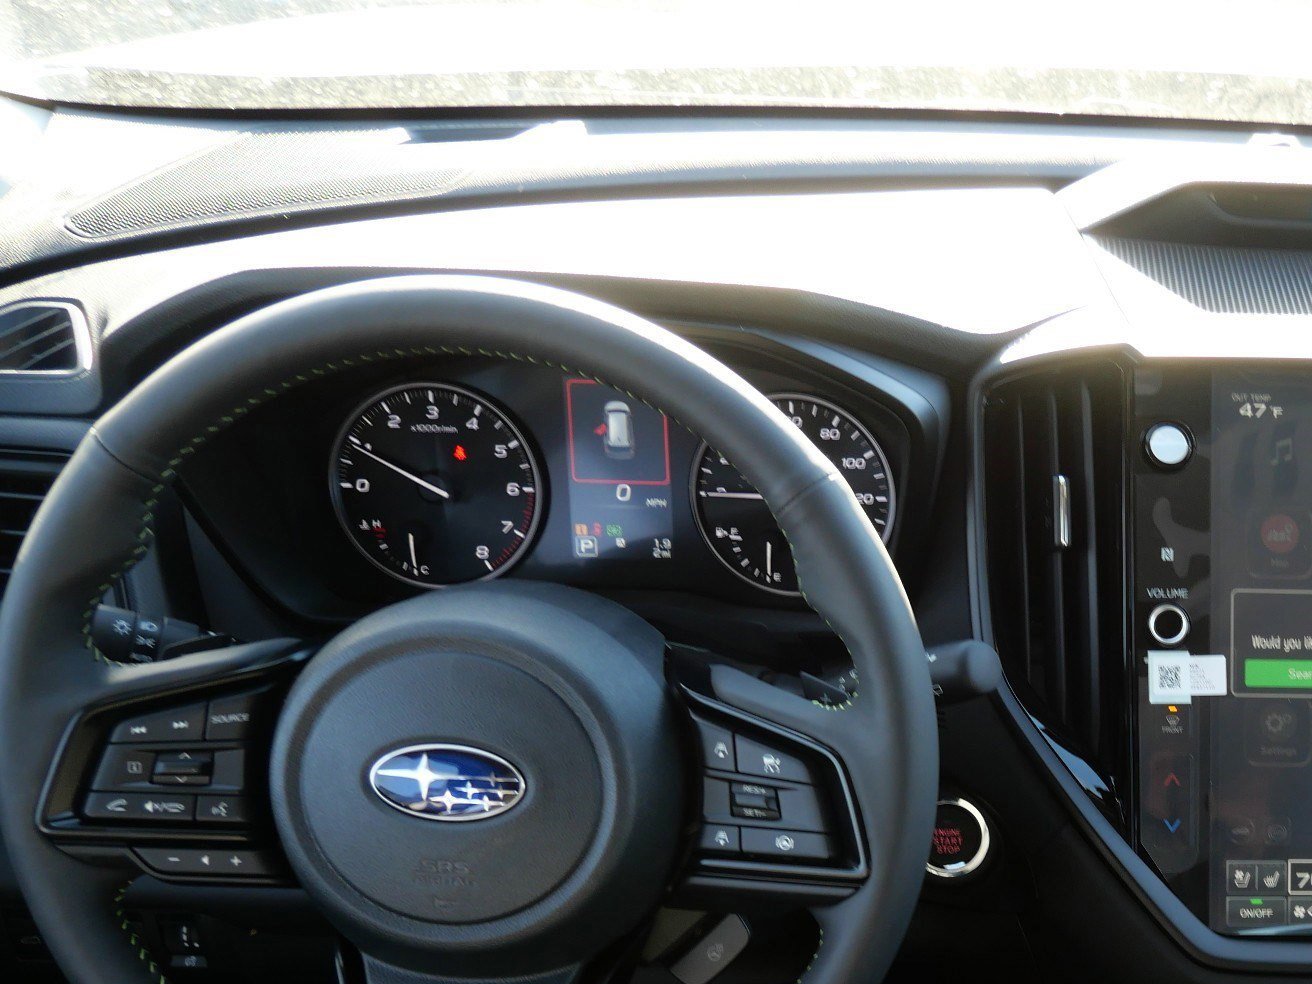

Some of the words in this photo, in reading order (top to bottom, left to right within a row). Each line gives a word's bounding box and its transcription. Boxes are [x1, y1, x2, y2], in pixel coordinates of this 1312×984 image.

[426, 405, 440, 420] 3
[387, 414, 402, 429] 2
[465, 417, 480, 431] 4
[820, 428, 841, 441] 80
[494, 444, 508, 459] 5
[842, 457, 867, 470] 100
[355, 478, 370, 493] 0
[506, 482, 521, 497] 6
[615, 483, 632, 502] 0
[501, 520, 514, 534] 7
[475, 545, 490, 560] 8
[1146, 587, 1190, 599] VOLUME
[1251, 634, 1281, 650] Would
[1283, 637, 1301, 653] you
[934, 837, 963, 846] START
[937, 845, 960, 855] STOP
